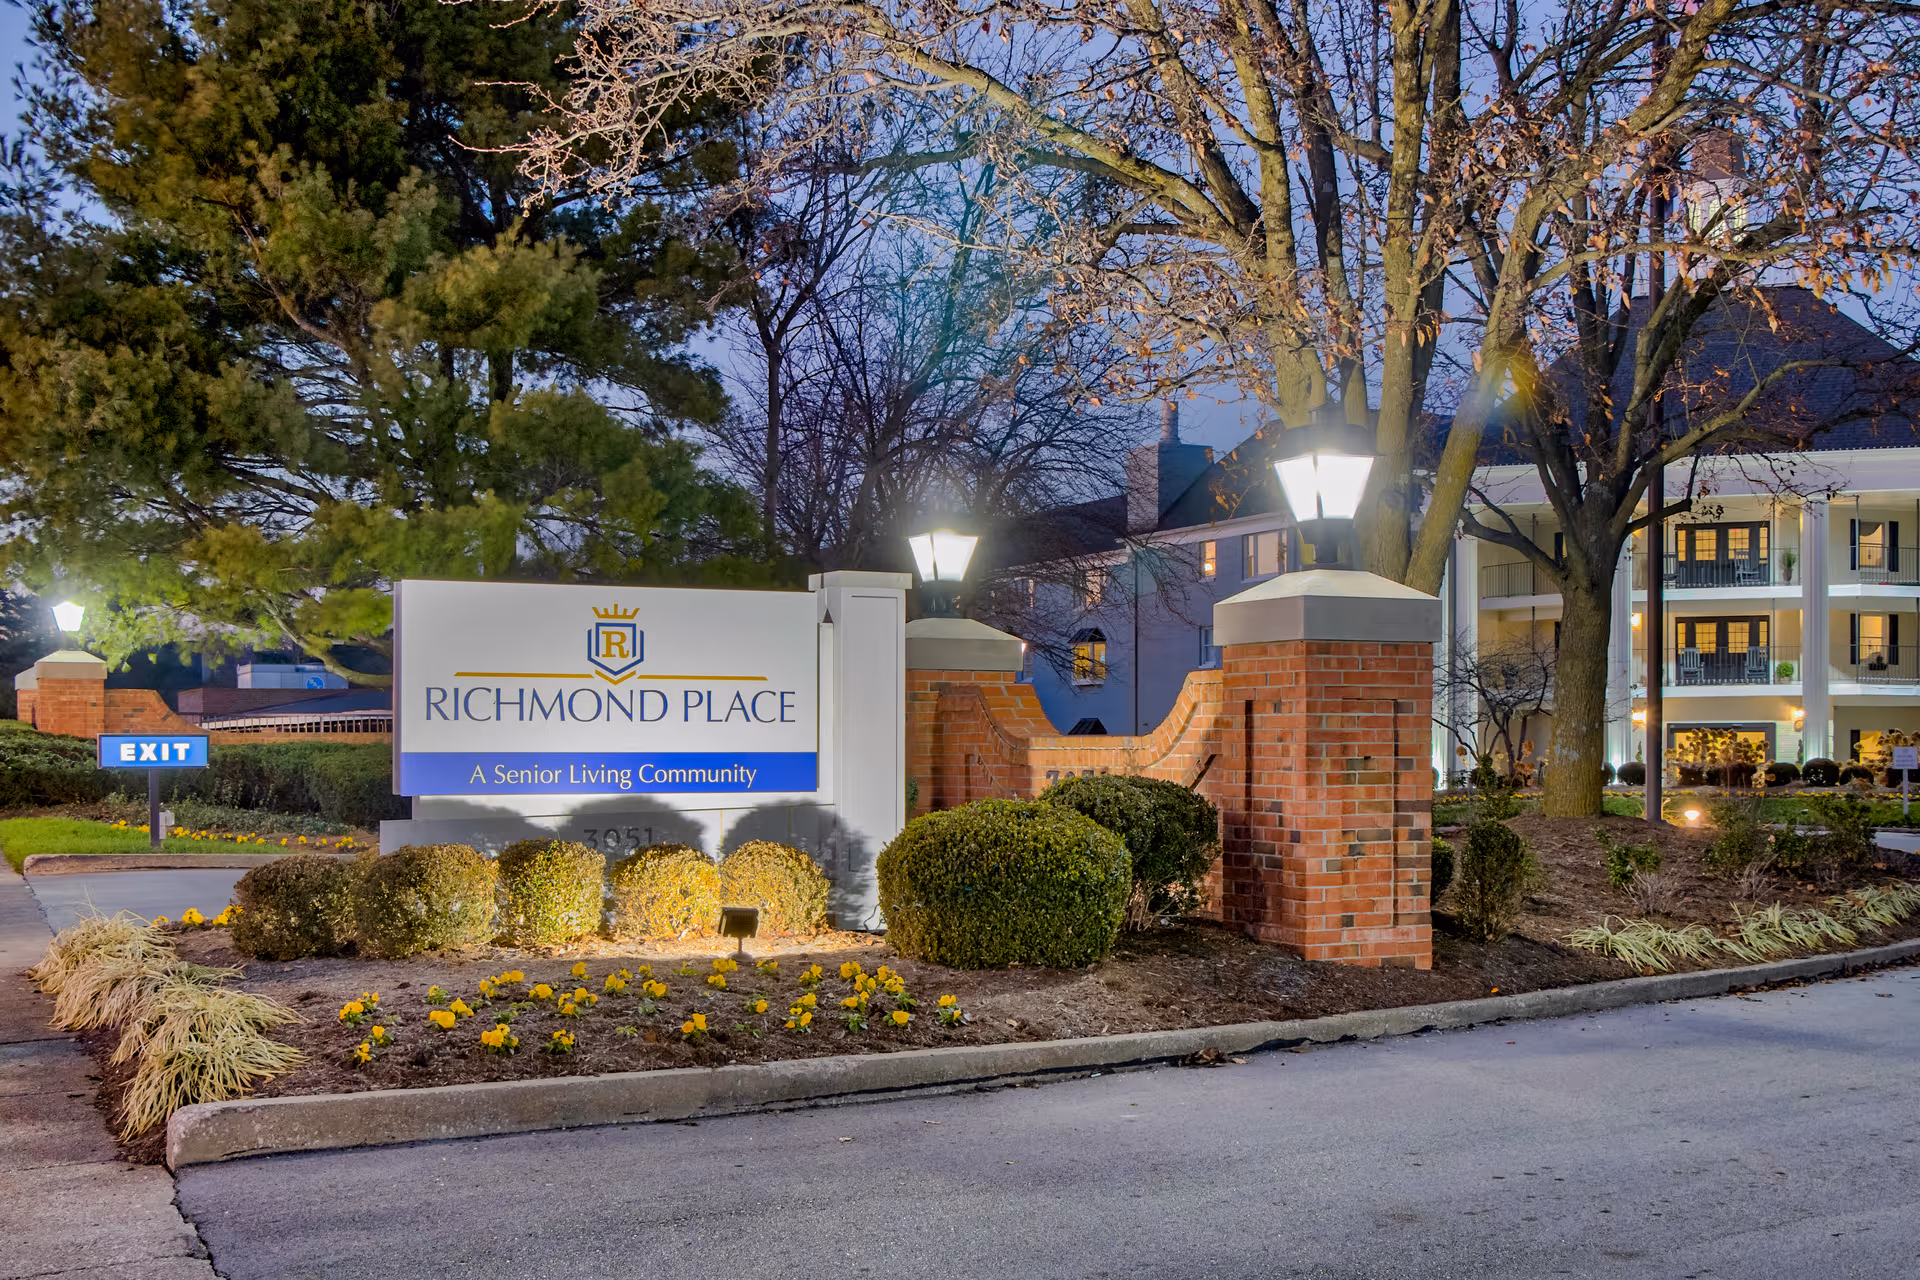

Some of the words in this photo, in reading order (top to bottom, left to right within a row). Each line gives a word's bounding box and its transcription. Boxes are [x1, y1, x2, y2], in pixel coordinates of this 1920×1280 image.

[601, 630, 630, 659] R
[425, 686, 668, 723] RICHMOND
[683, 690, 796, 723] PLACE
[119, 742, 191, 762] EXIT
[469, 764, 487, 784] A
[494, 763, 563, 784] Senior
[569, 763, 633, 790] Living
[638, 763, 757, 789] Community
[583, 827, 653, 850] 3051
